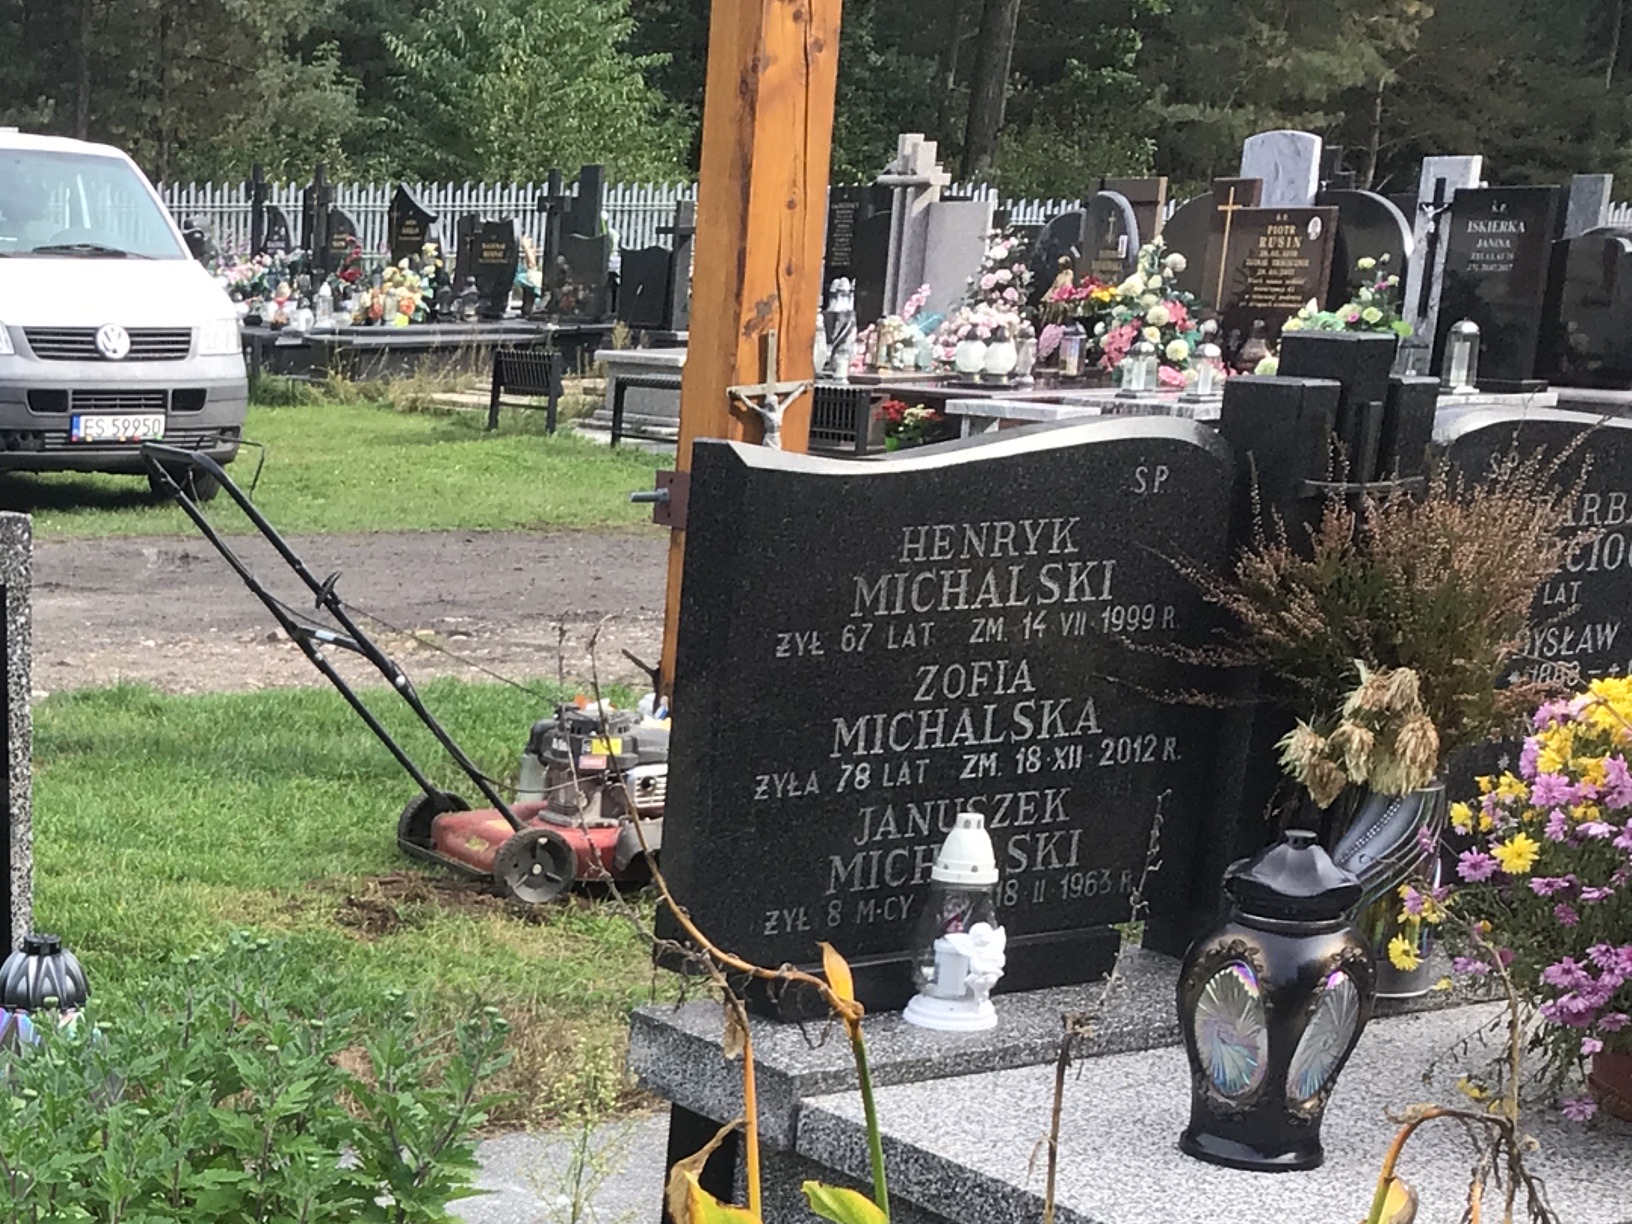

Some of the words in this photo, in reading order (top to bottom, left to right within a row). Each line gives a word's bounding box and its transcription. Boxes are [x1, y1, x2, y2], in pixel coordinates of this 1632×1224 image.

[83, 418, 105, 437] ES
[111, 418, 162, 437] 59950
[899, 517, 1080, 563] HENRYK
[850, 559, 1116, 619] MICHALSKI
[1543, 581, 1581, 605] LAT
[841, 623, 873, 652] 67
[887, 622, 934, 650] LAT
[1023, 609, 1047, 640] 14
[1101, 603, 1155, 634] 1999
[914, 659, 1036, 701] ZOFIA
[829, 697, 1103, 758] MICHALSKA
[836, 763, 870, 792] 78
[883, 759, 930, 787] LAT
[1099, 733, 1157, 767] 2012
[824, 828, 1083, 896] MICHSKI
[827, 900, 842, 927] 8
[1060, 868, 1112, 899] 1963
